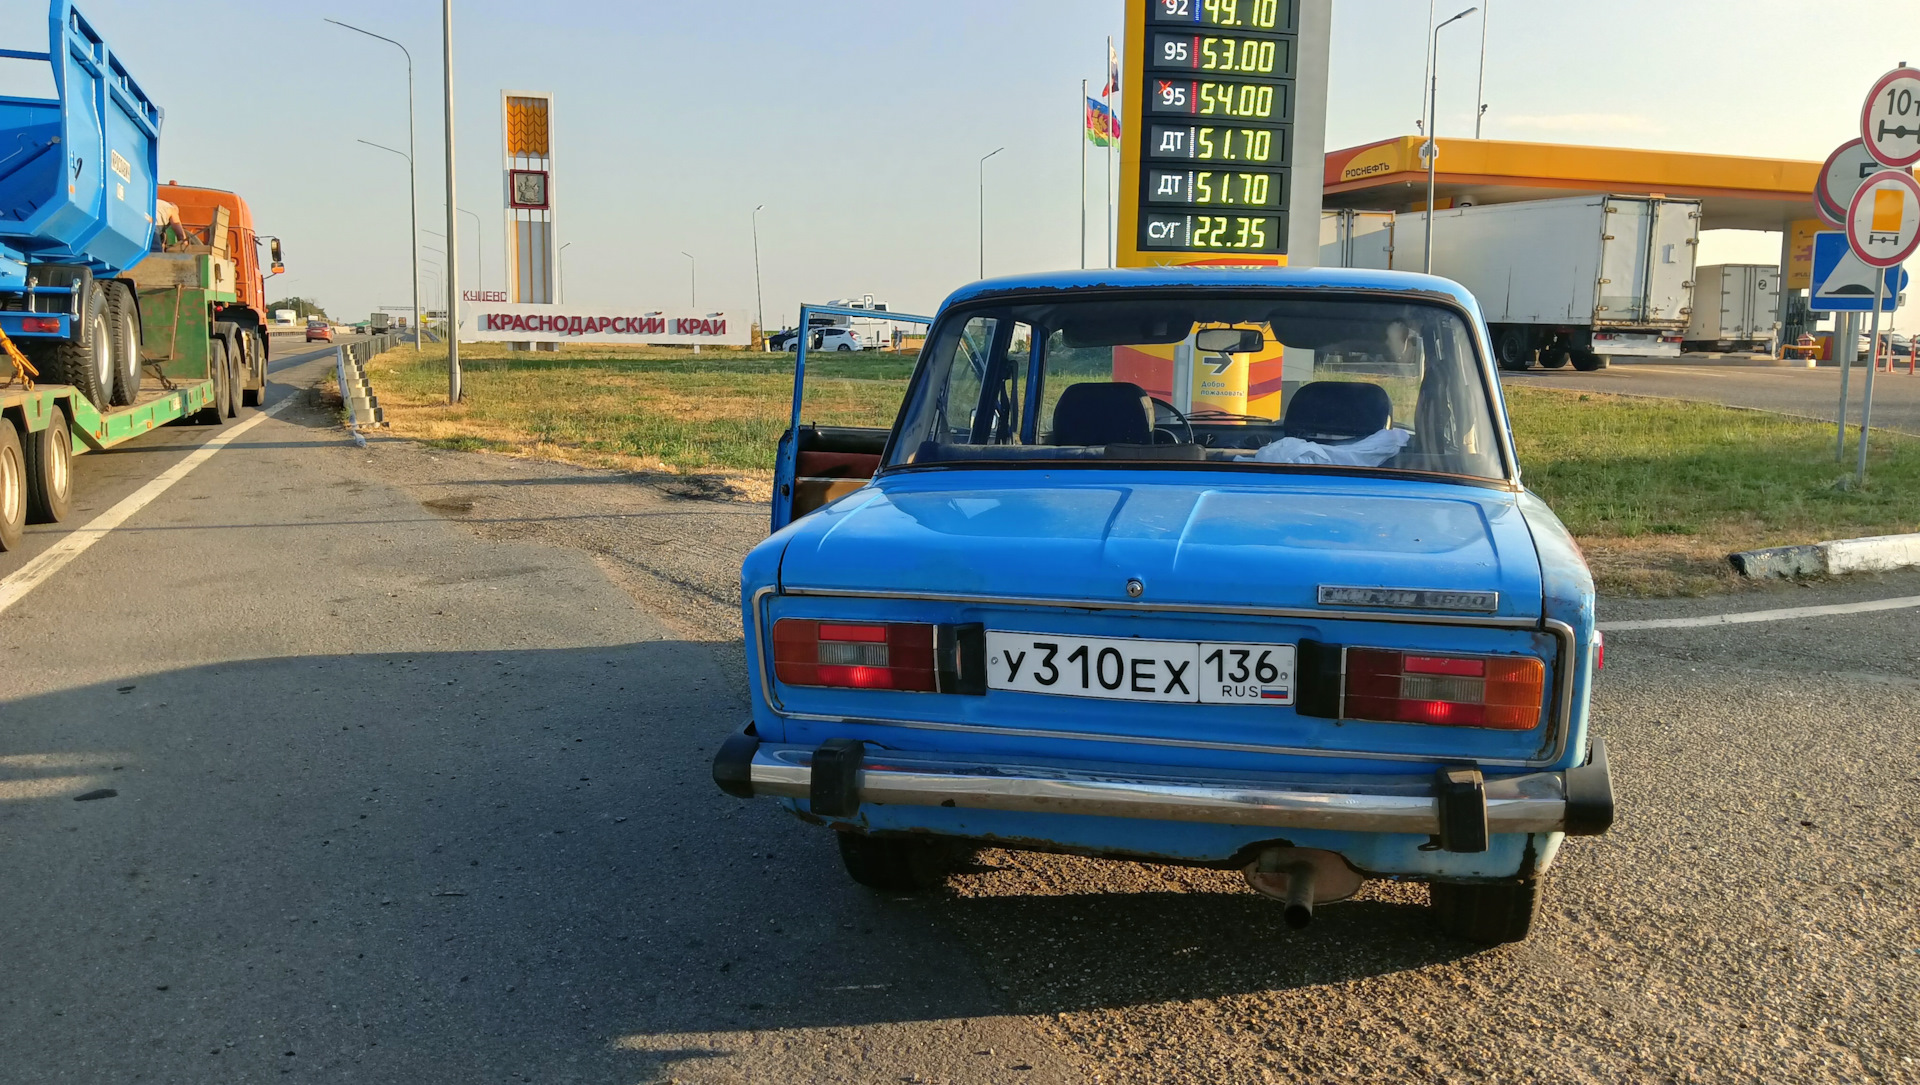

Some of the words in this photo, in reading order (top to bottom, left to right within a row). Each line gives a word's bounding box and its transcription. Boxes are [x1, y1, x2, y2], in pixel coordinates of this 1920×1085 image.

[1165, 0, 1188, 16] 92
[1164, 42, 1187, 60] 95
[1202, 38, 1275, 72] 53.00
[1162, 88, 1186, 106] 95
[1200, 83, 1273, 117] 54.00
[1160, 131, 1185, 152] ДТ
[1198, 128, 1271, 161] 51.70
[1345, 162, 1390, 178] РОСНЕФТЬ
[1158, 175, 1182, 195] ДТ
[1197, 172, 1269, 204] 51.70
[1148, 221, 1181, 239] СУГ
[1193, 216, 1266, 248] 22.35
[487, 311, 665, 336] КРАСНОДАРСКИЙ
[676, 311, 726, 335] КРАЙ
[1204, 649, 1279, 683] 136
[1222, 685, 1259, 698] RUS
